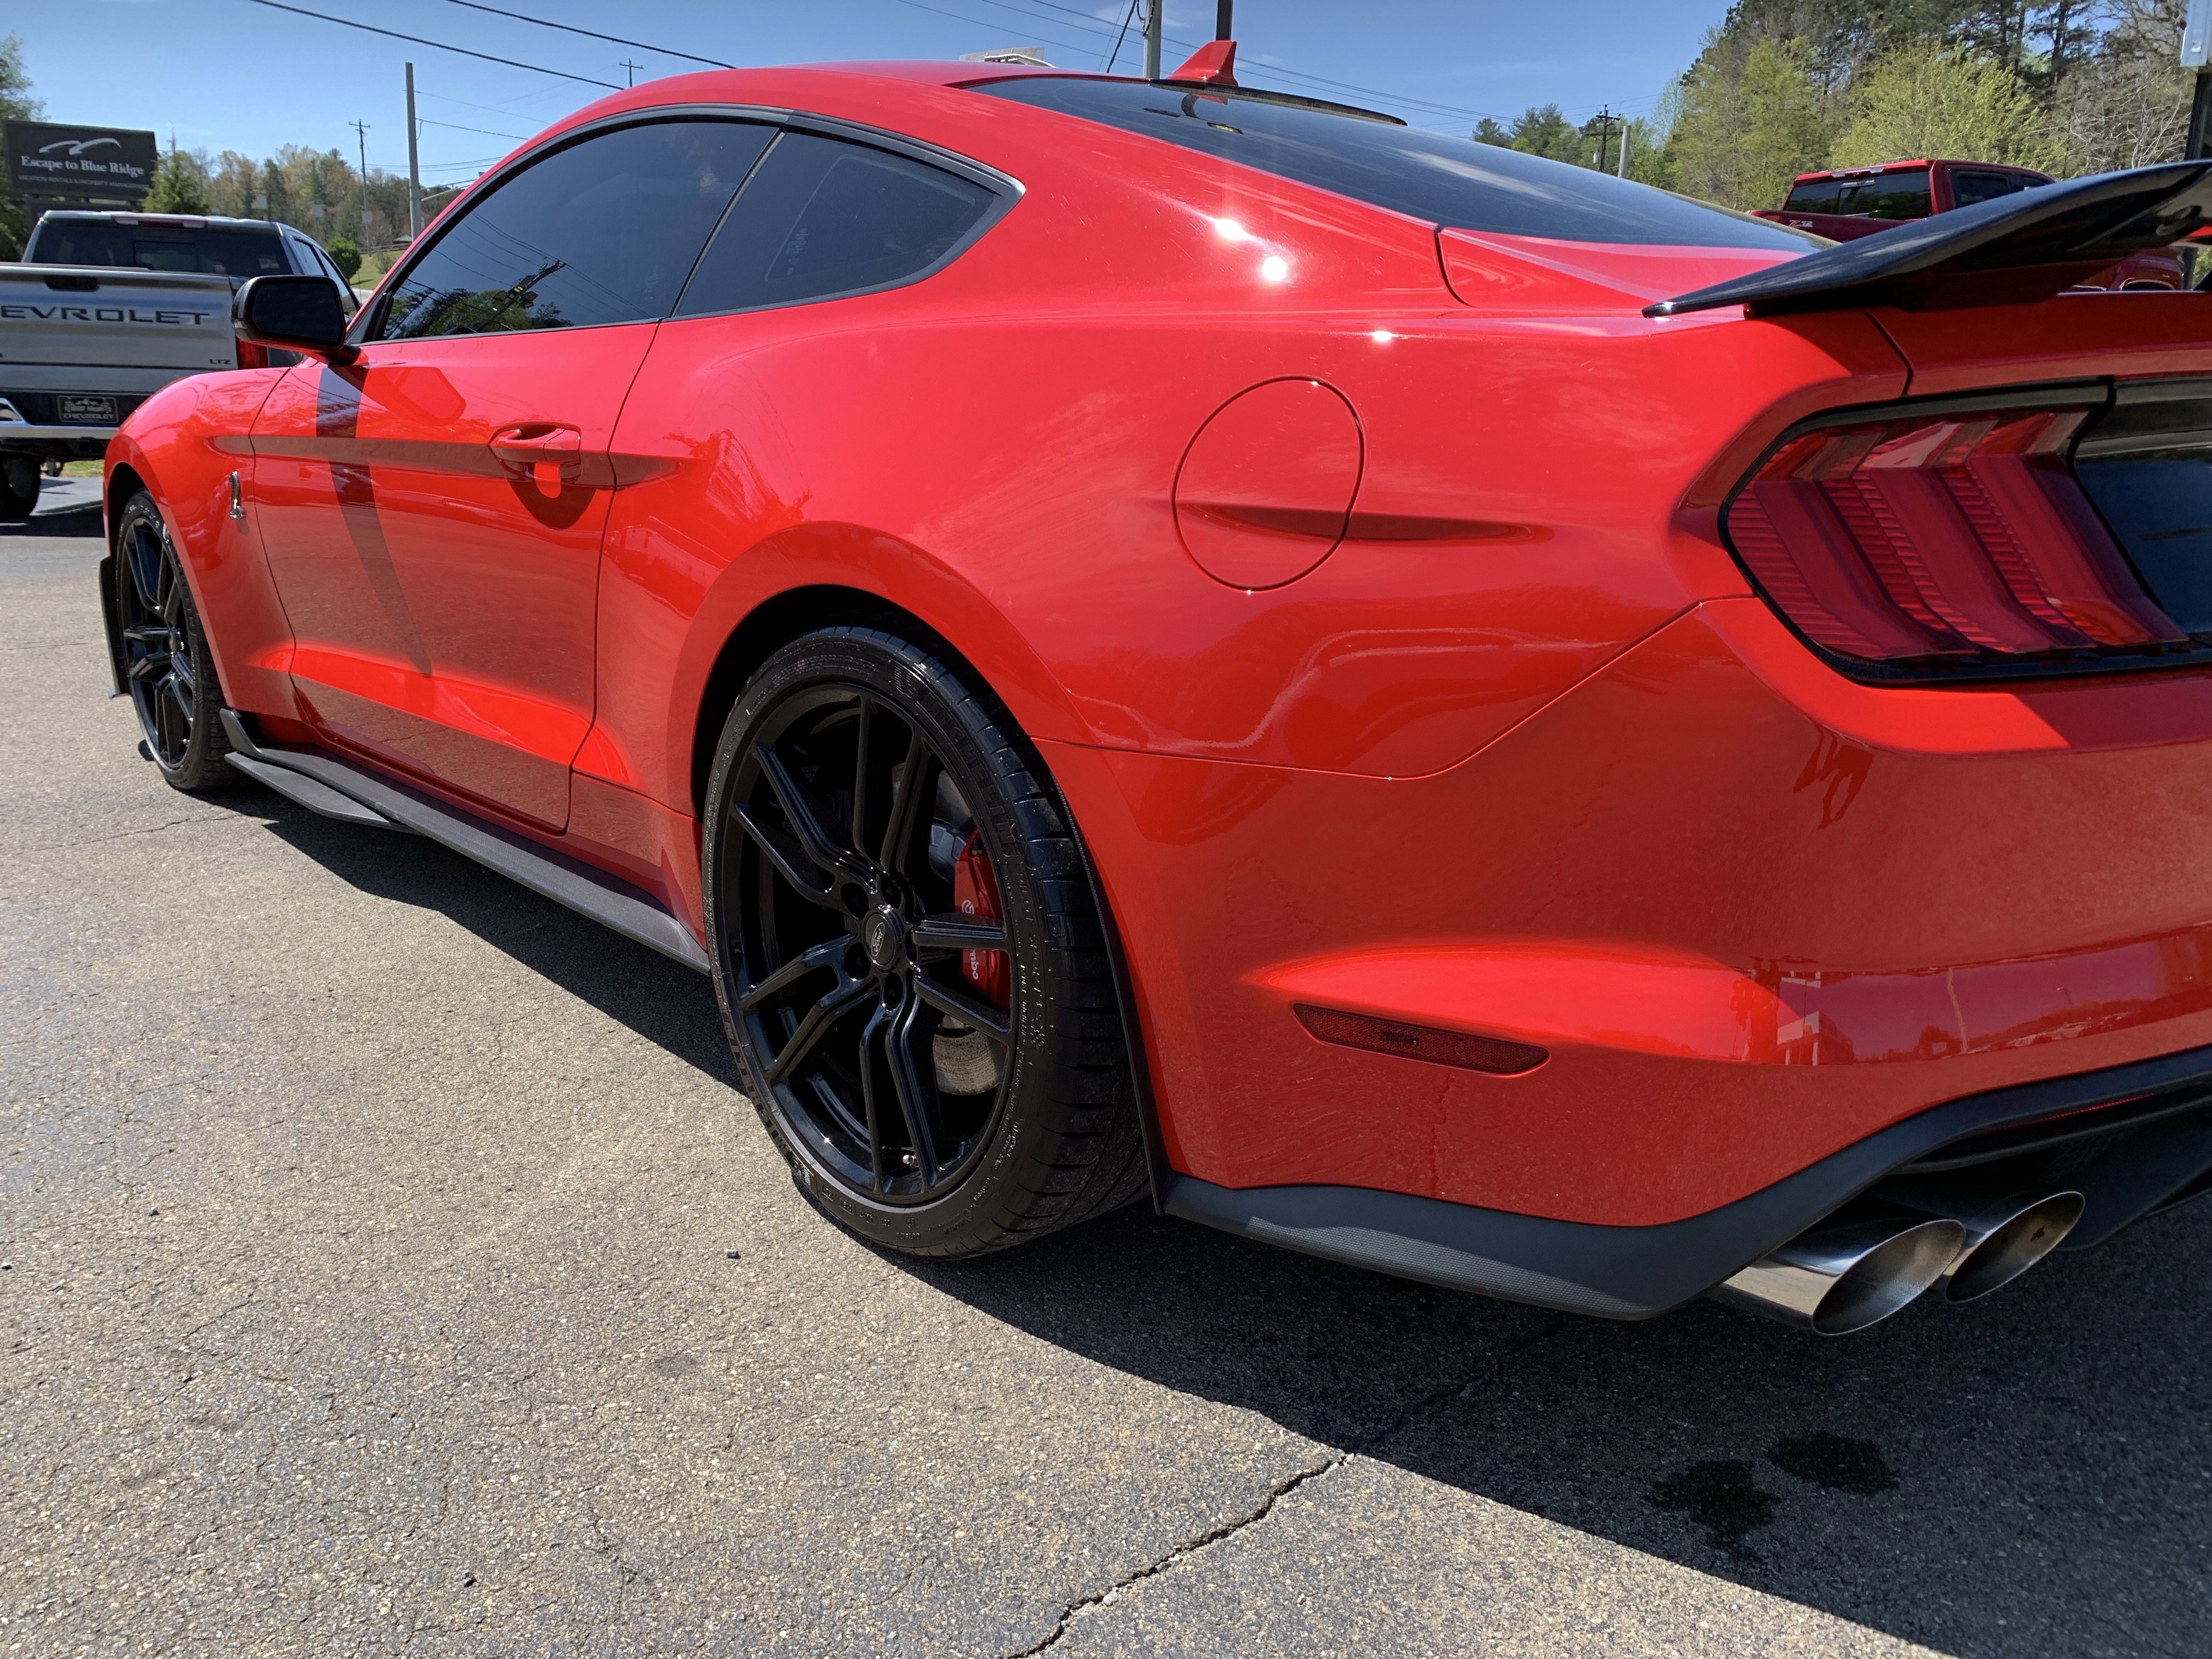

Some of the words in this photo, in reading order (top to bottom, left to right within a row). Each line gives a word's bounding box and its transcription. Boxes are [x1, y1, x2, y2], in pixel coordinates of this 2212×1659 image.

[21, 155, 63, 171] Escape
[65, 160, 78, 170] to
[80, 160, 107, 171] Blue
[109, 162, 144, 178] Ridge
[1, 306, 210, 325] EVROLET
[873, 928, 883, 952] Ford
